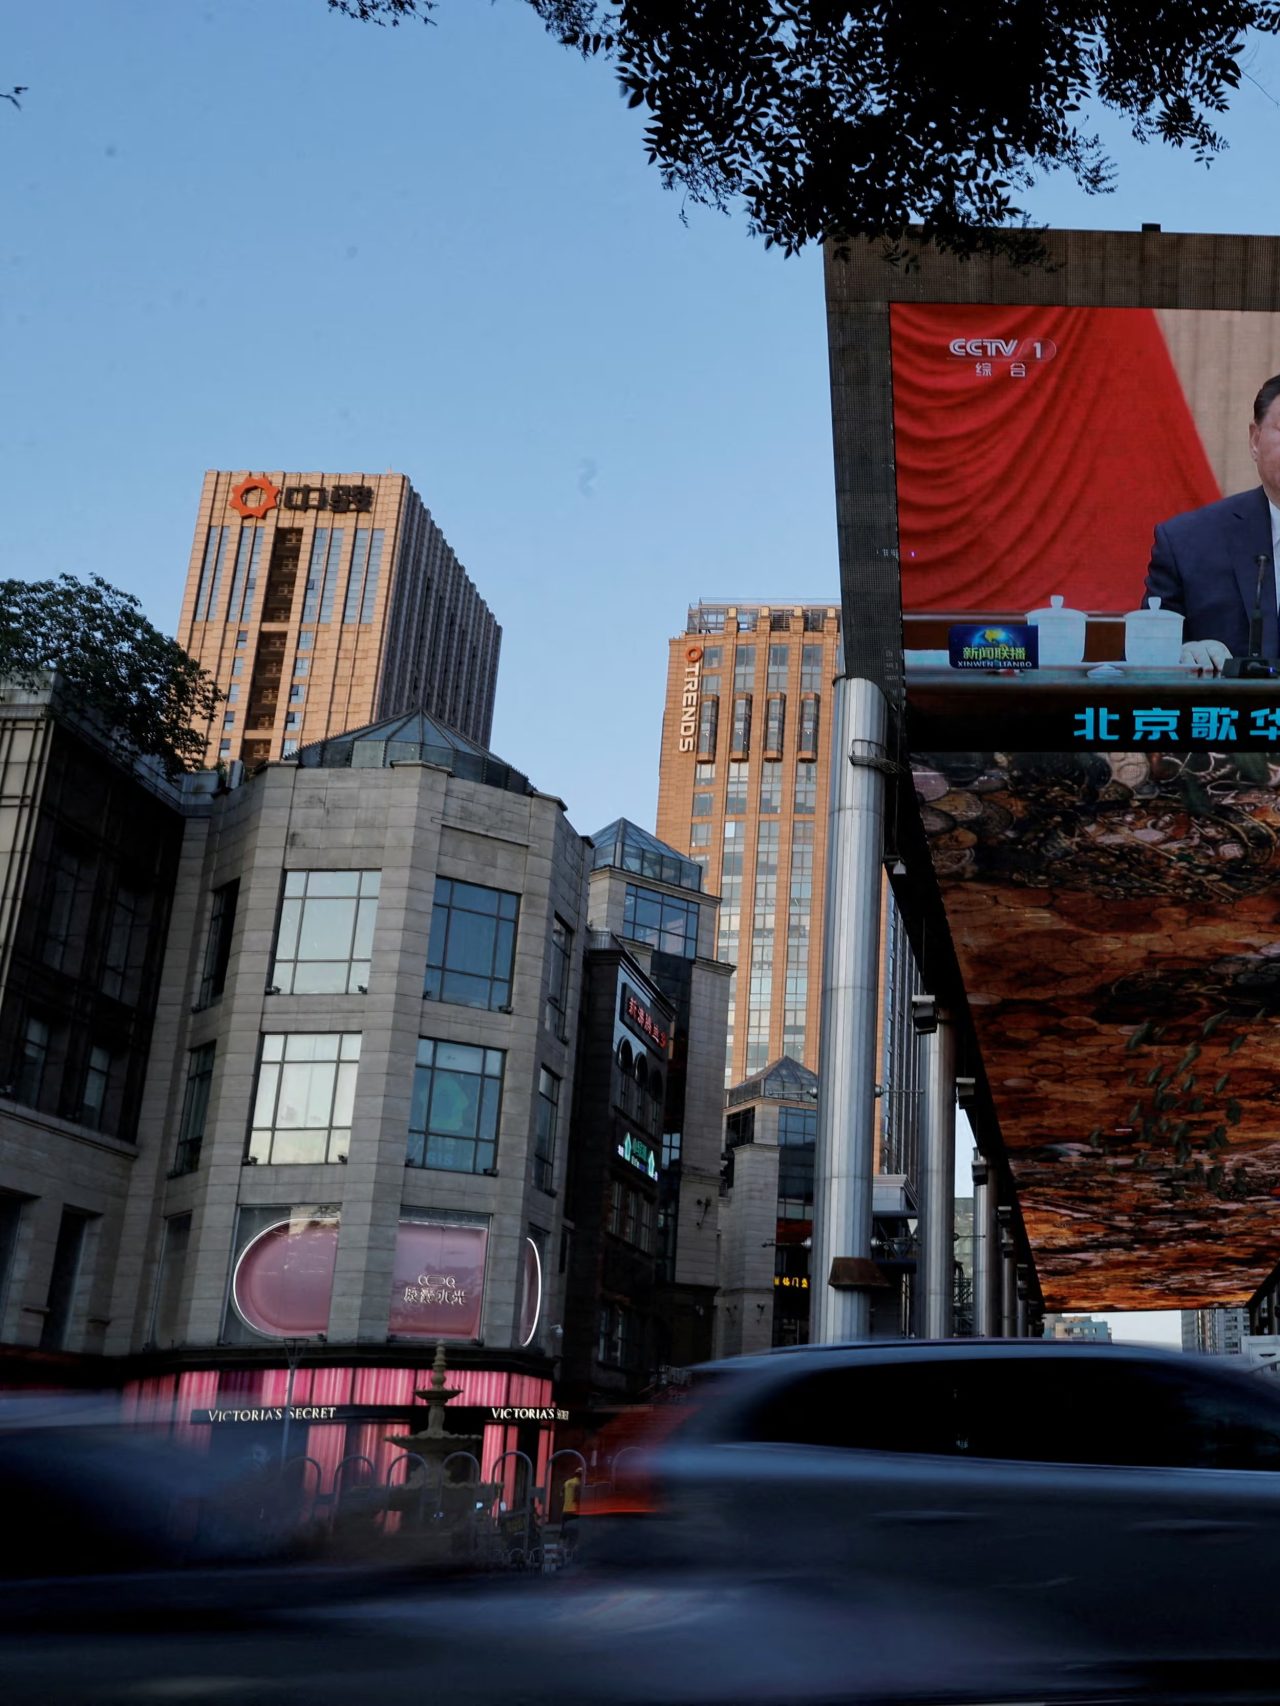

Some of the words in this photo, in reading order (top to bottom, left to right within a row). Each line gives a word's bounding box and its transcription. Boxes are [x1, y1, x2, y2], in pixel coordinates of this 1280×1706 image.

[949, 338, 1018, 356] CCTV
[1033, 342, 1042, 359] 1
[962, 647, 1026, 660] 新闻联播
[957, 660, 994, 668] XINWEN
[999, 660, 1033, 668] LIANBO
[679, 662, 700, 752] TRENDS
[208, 1408, 282, 1422] VICTORIA'S
[289, 1406, 337, 1420] SECRET
[491, 1407, 555, 1419] VICTORIA'S
